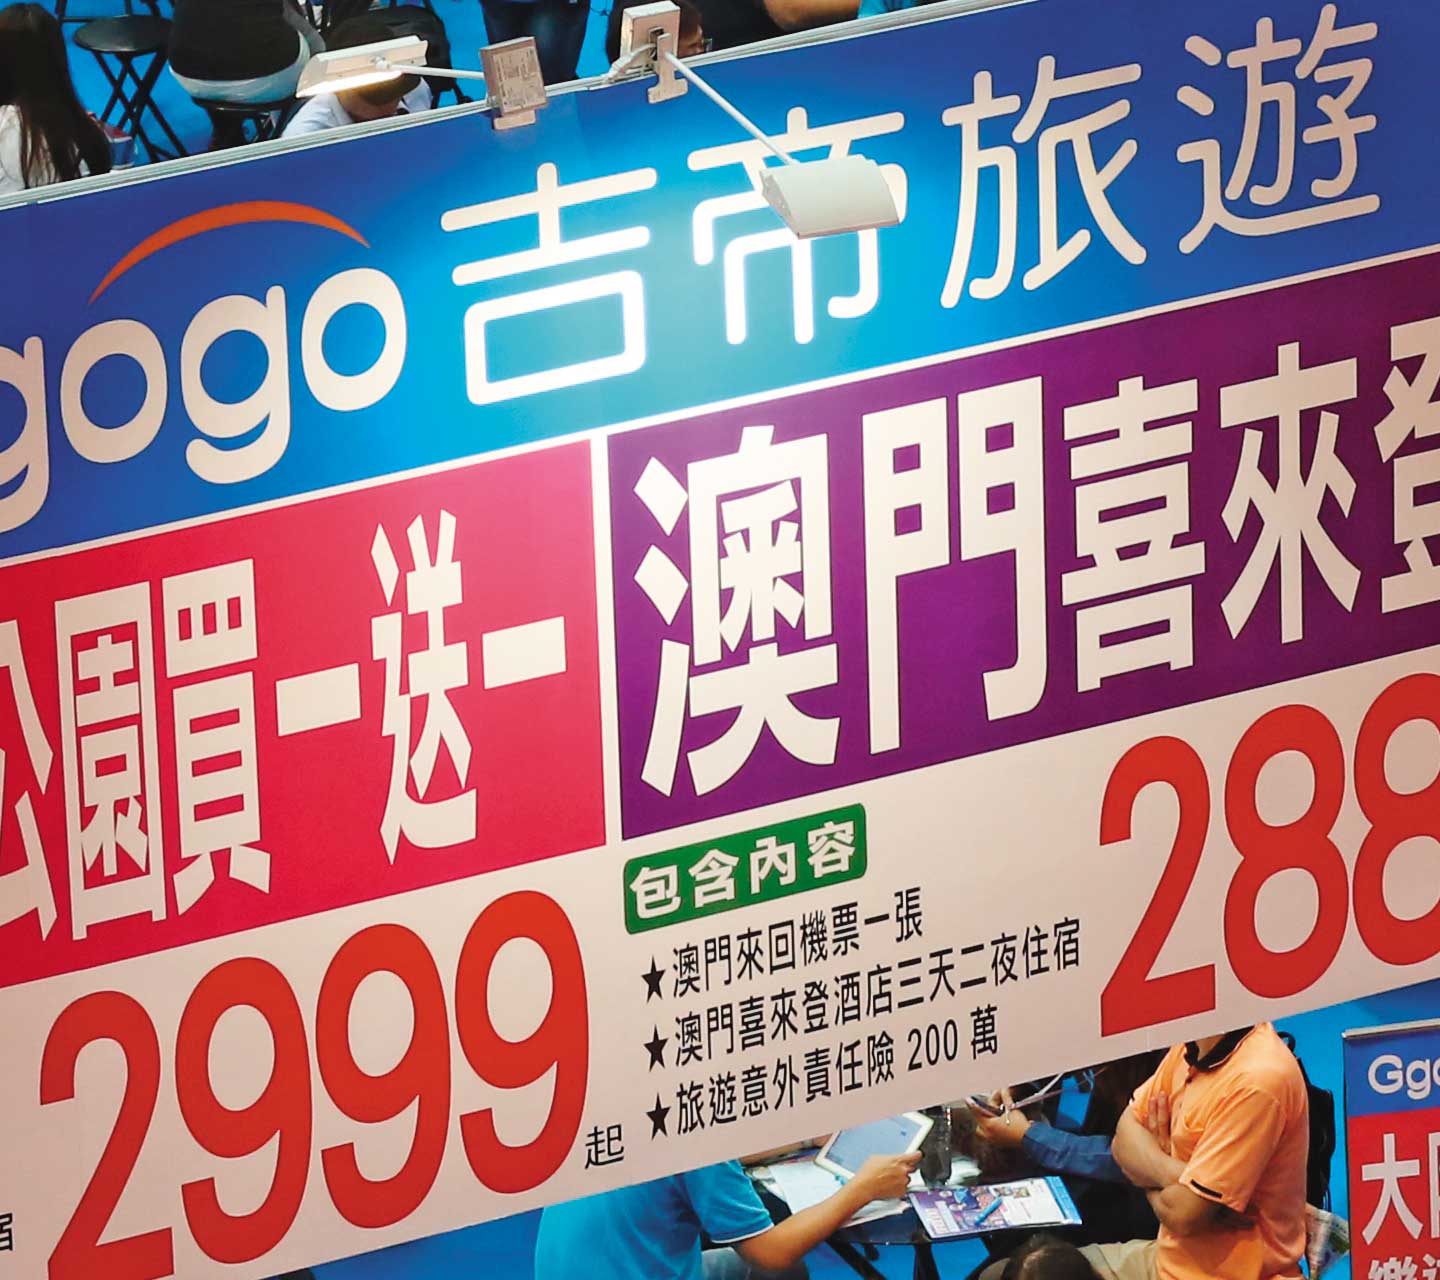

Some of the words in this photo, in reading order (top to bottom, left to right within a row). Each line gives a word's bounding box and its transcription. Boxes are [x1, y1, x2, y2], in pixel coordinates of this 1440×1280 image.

[439, 0, 1385, 409] 吉帝旅遊
[627, 816, 860, 925] 包含內容
[670, 885, 925, 1002] 澳門來回機票一張
[672, 916, 1083, 1067] 澳門喜來登酒店三天二夜住宿
[41, 886, 589, 1280] 2999
[584, 1124, 626, 1168] 起
[673, 1029, 897, 1138] 旅遊意外責任險
[906, 1022, 966, 1077] 200
